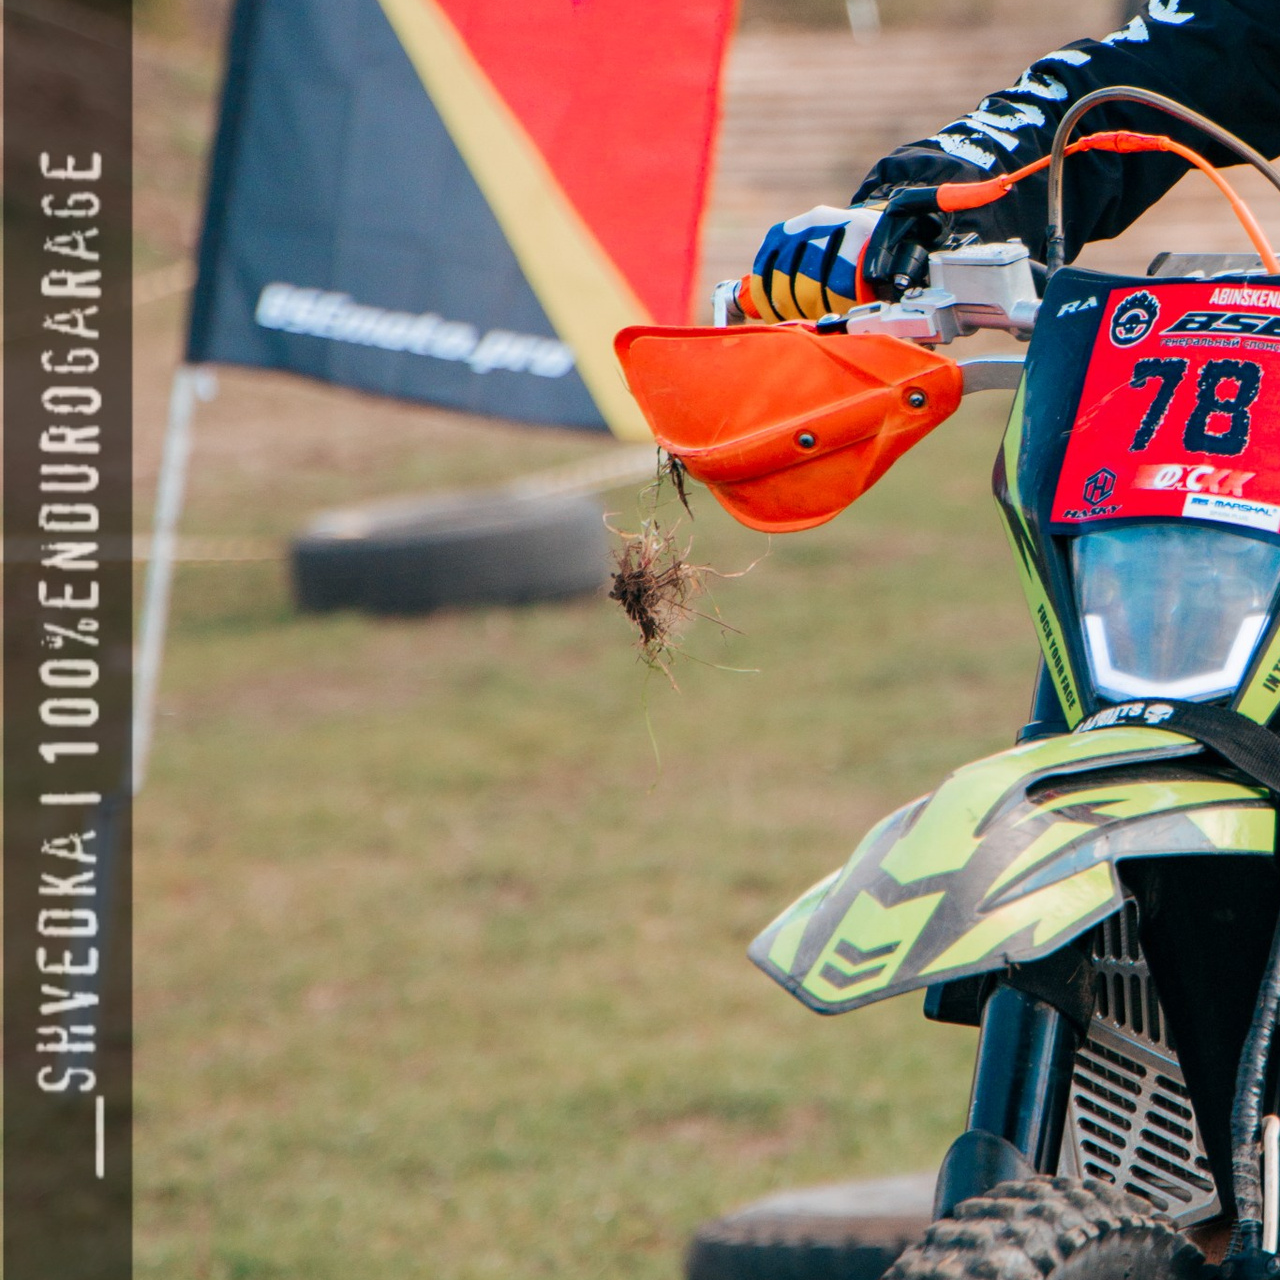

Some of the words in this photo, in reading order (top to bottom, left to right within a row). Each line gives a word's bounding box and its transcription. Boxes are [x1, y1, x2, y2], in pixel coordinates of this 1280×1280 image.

[1160, 335, 1240, 349] генеральный
[1129, 357, 1264, 457] 78
[1062, 504, 1122, 519] HASKY
[1037, 603, 1053, 640] FUCK
[1048, 638, 1065, 677] YOUR
[1060, 674, 1076, 711] FACE
